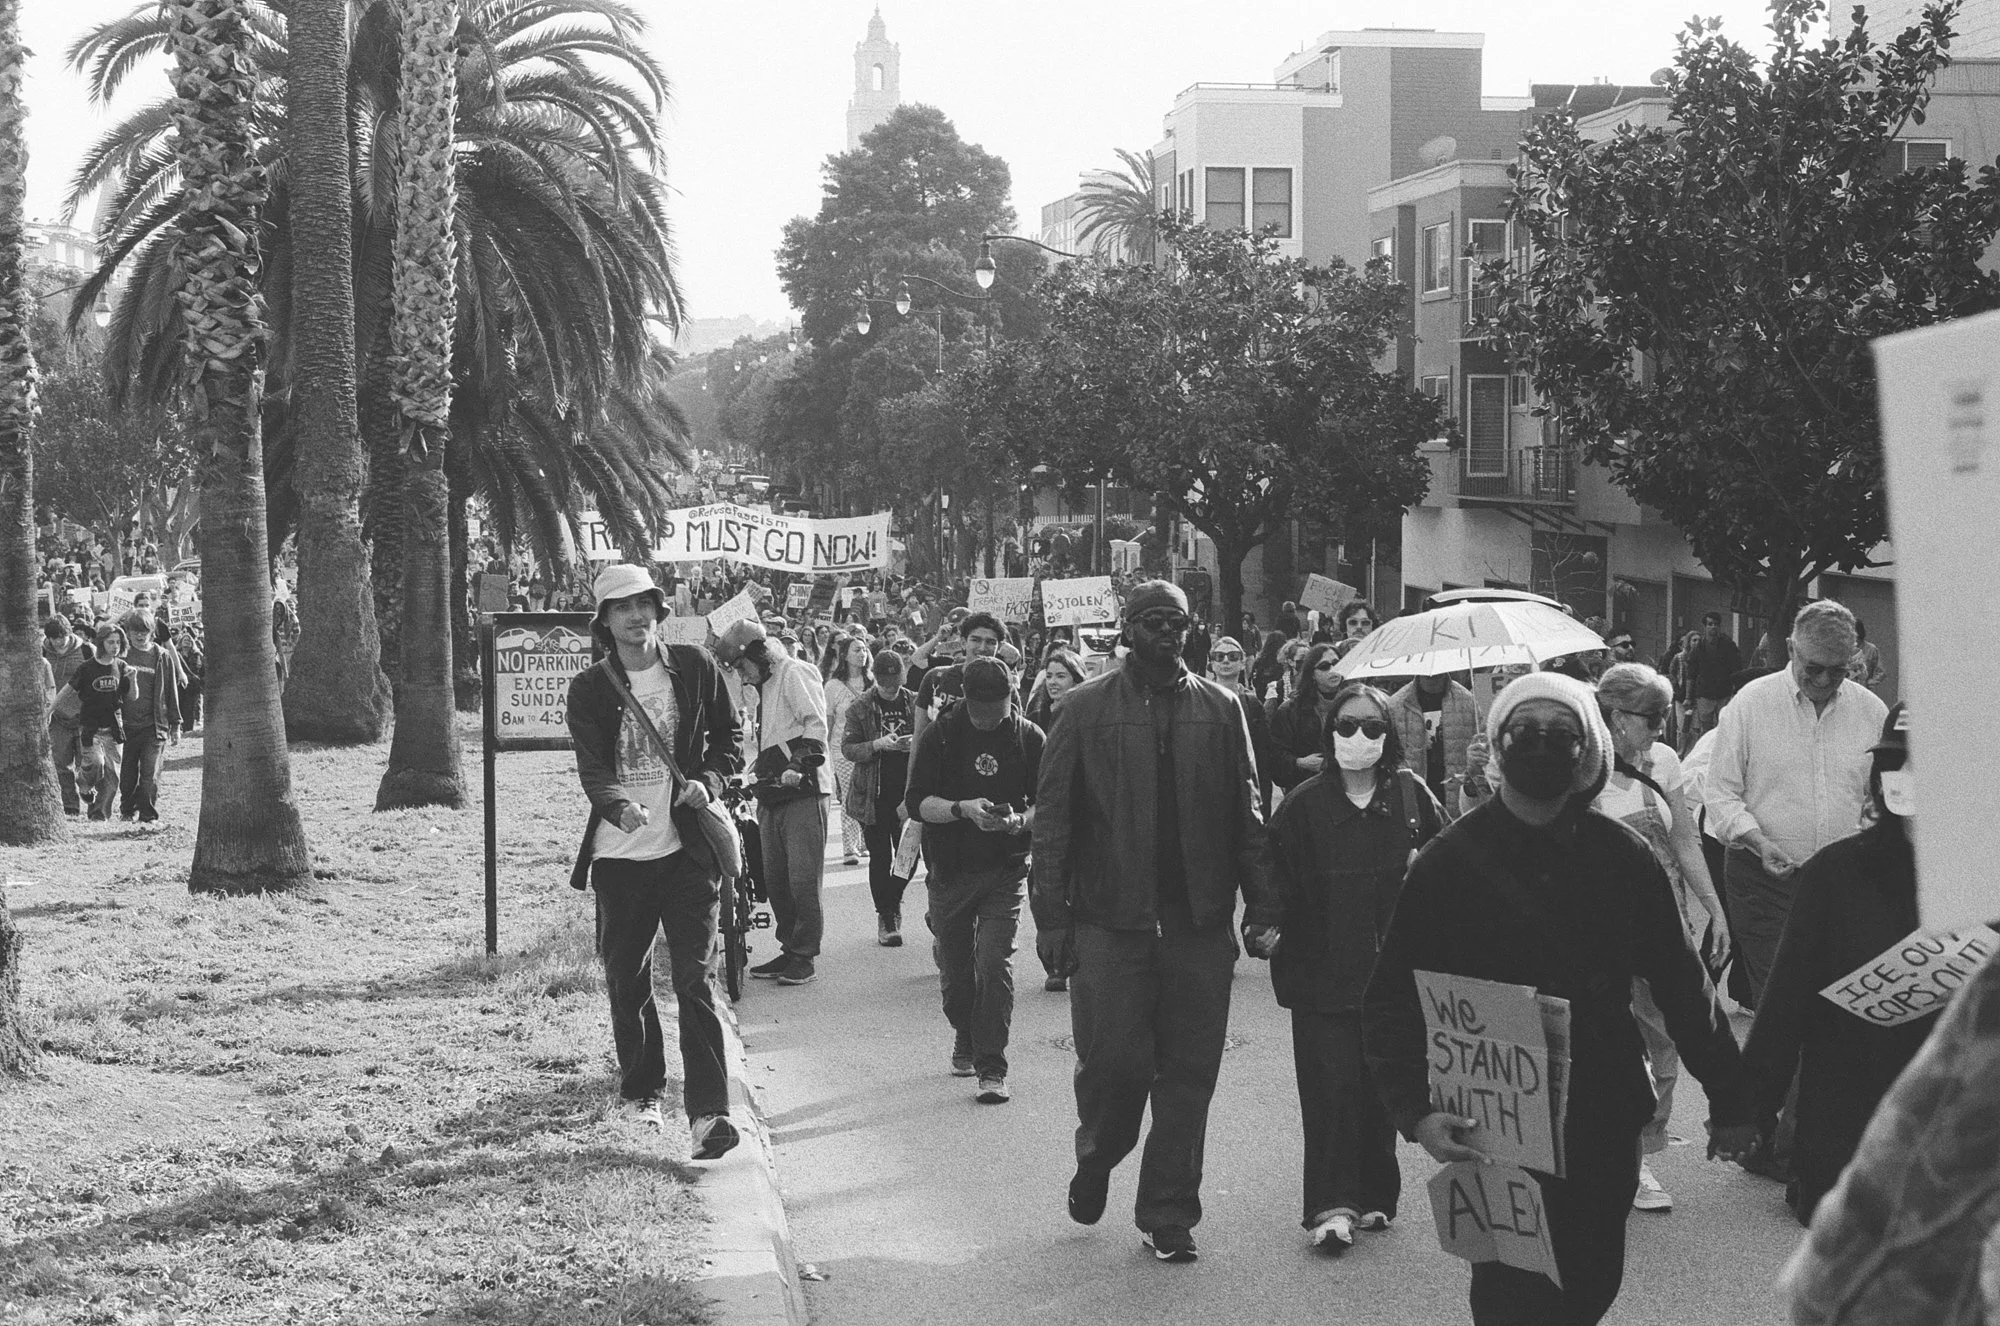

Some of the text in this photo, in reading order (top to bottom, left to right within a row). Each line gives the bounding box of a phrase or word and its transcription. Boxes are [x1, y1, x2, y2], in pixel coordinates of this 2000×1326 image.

[686, 519, 758, 555] MUST
[764, 529, 804, 564] GO
[813, 531, 876, 566] NOW!
[1057, 594, 1103, 610] STOLEN
[497, 651, 591, 672] NO PARKING
[511, 693, 567, 707] SUNDA
[1835, 963, 1910, 1010] ICE
[1864, 983, 1939, 1022] COPS
[1426, 985, 1486, 1034] We
[1432, 1031, 1540, 1096] STAND
